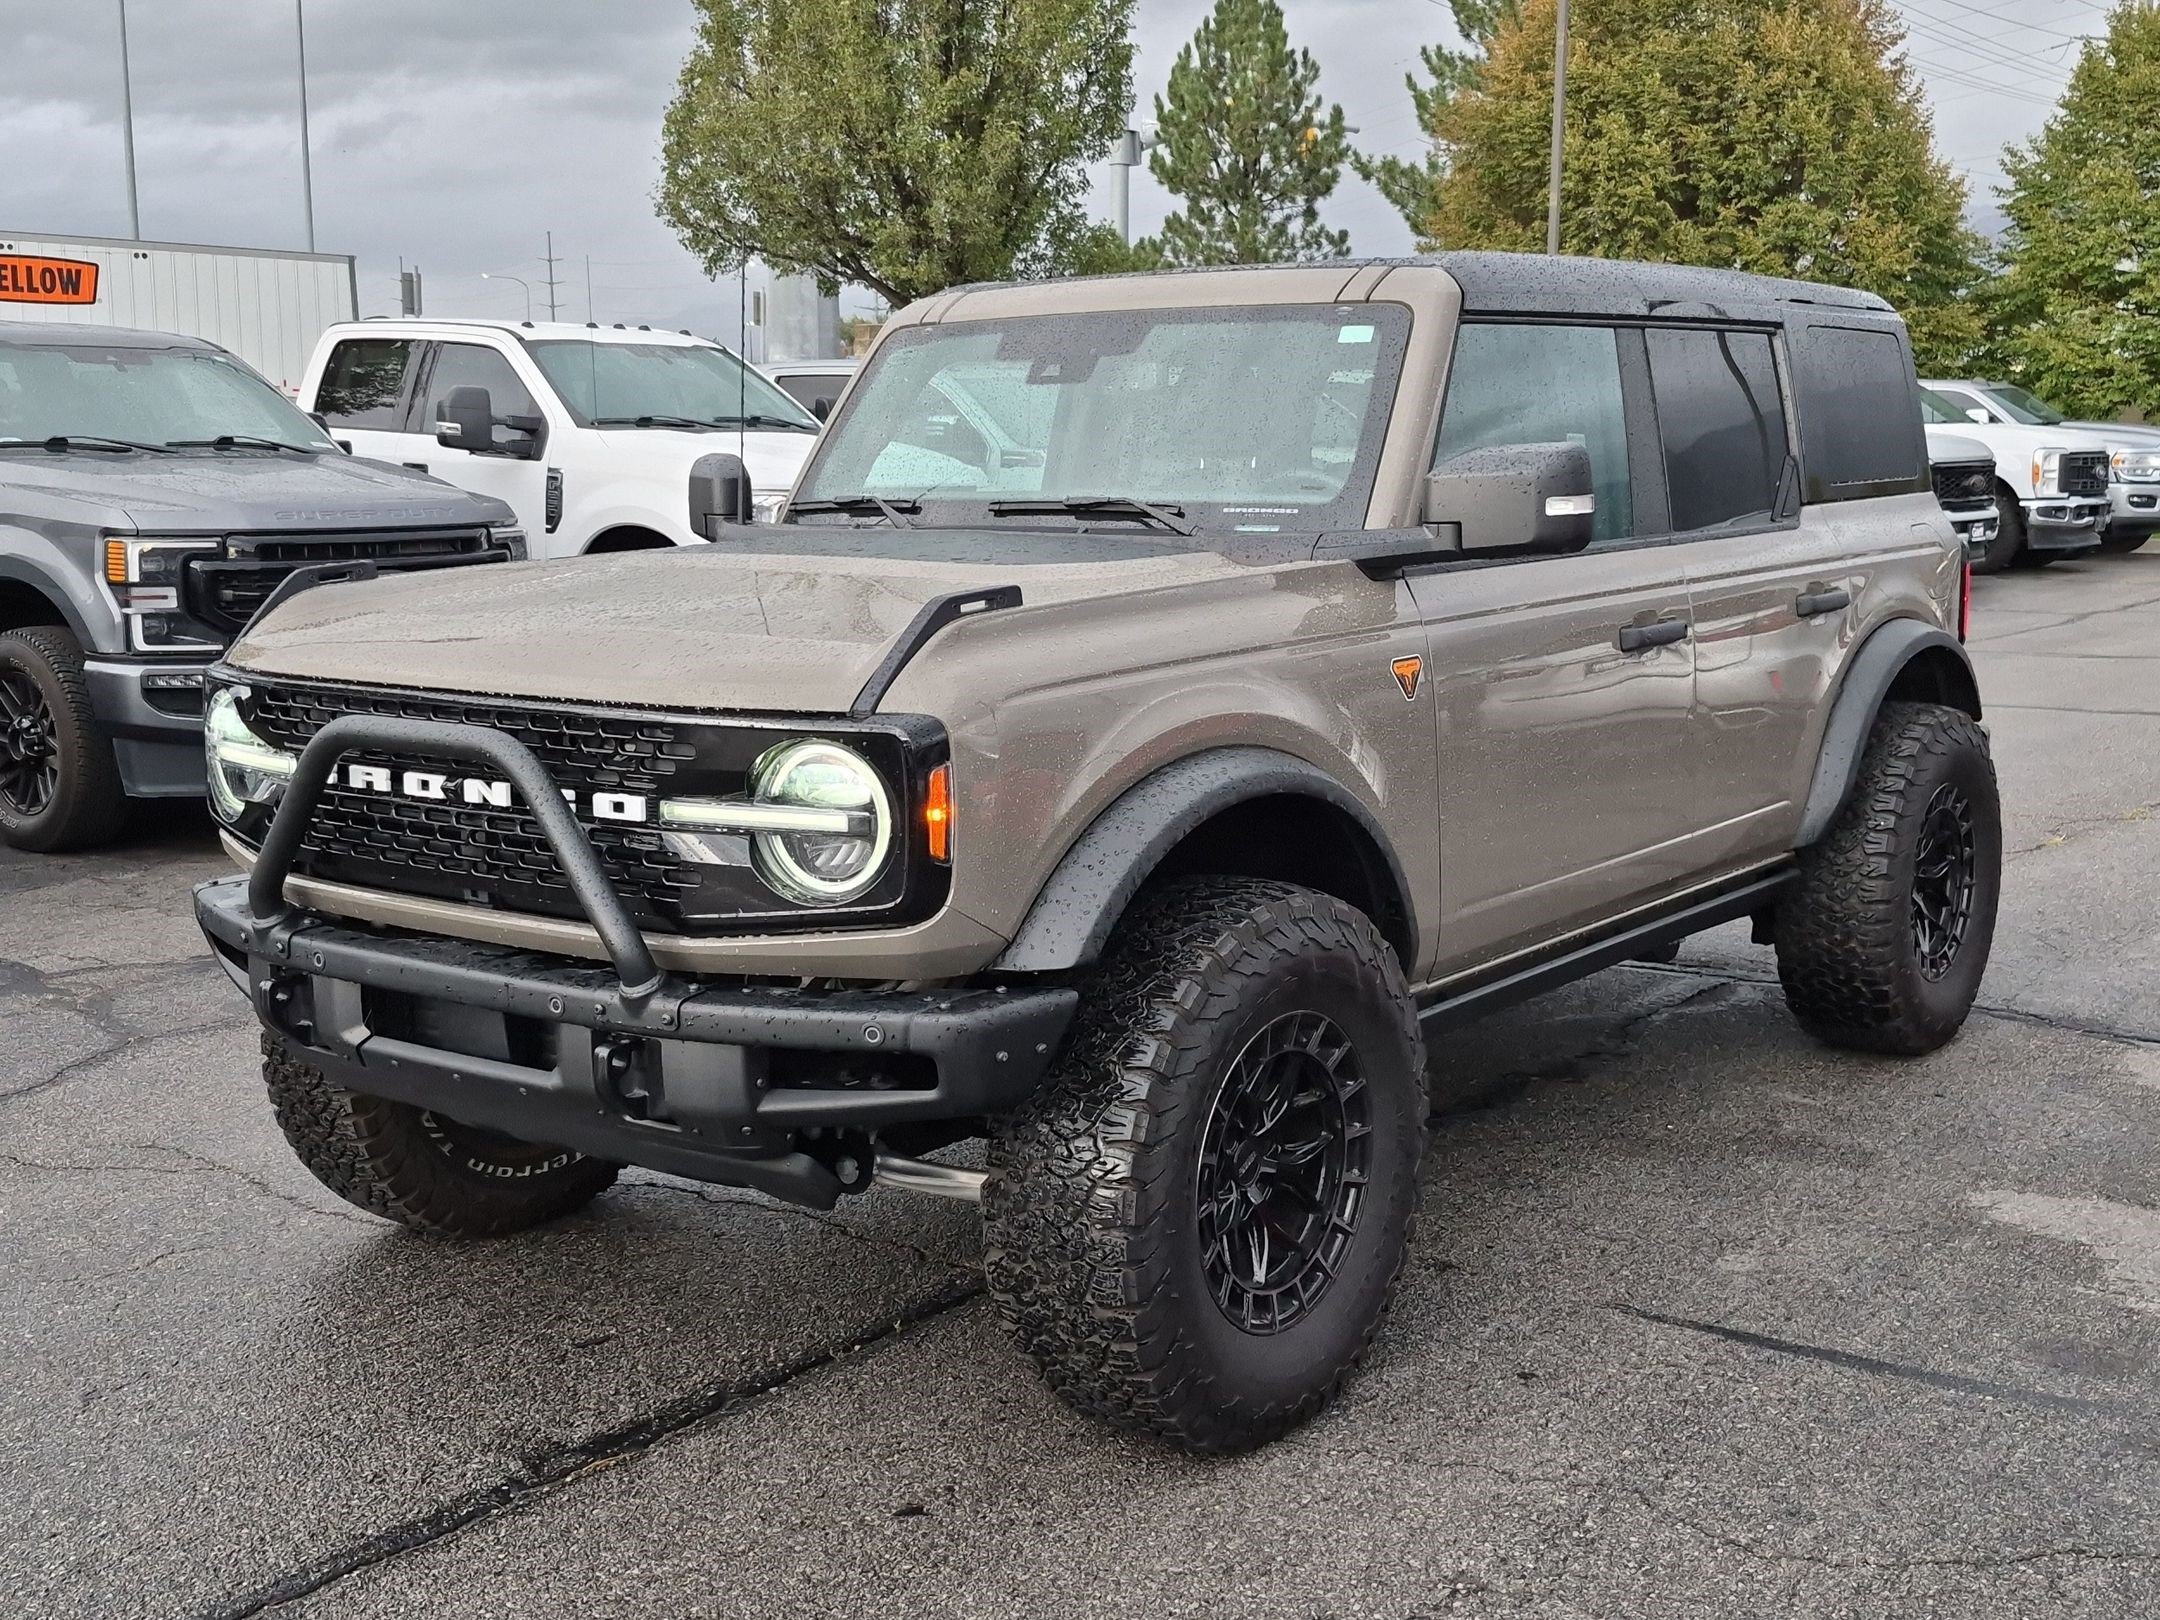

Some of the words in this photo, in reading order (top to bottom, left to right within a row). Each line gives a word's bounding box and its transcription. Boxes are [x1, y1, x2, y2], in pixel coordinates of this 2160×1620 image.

[274, 509, 379, 521] SUPER
[387, 506, 455, 519] DUTY
[326, 763, 646, 822] RONO
